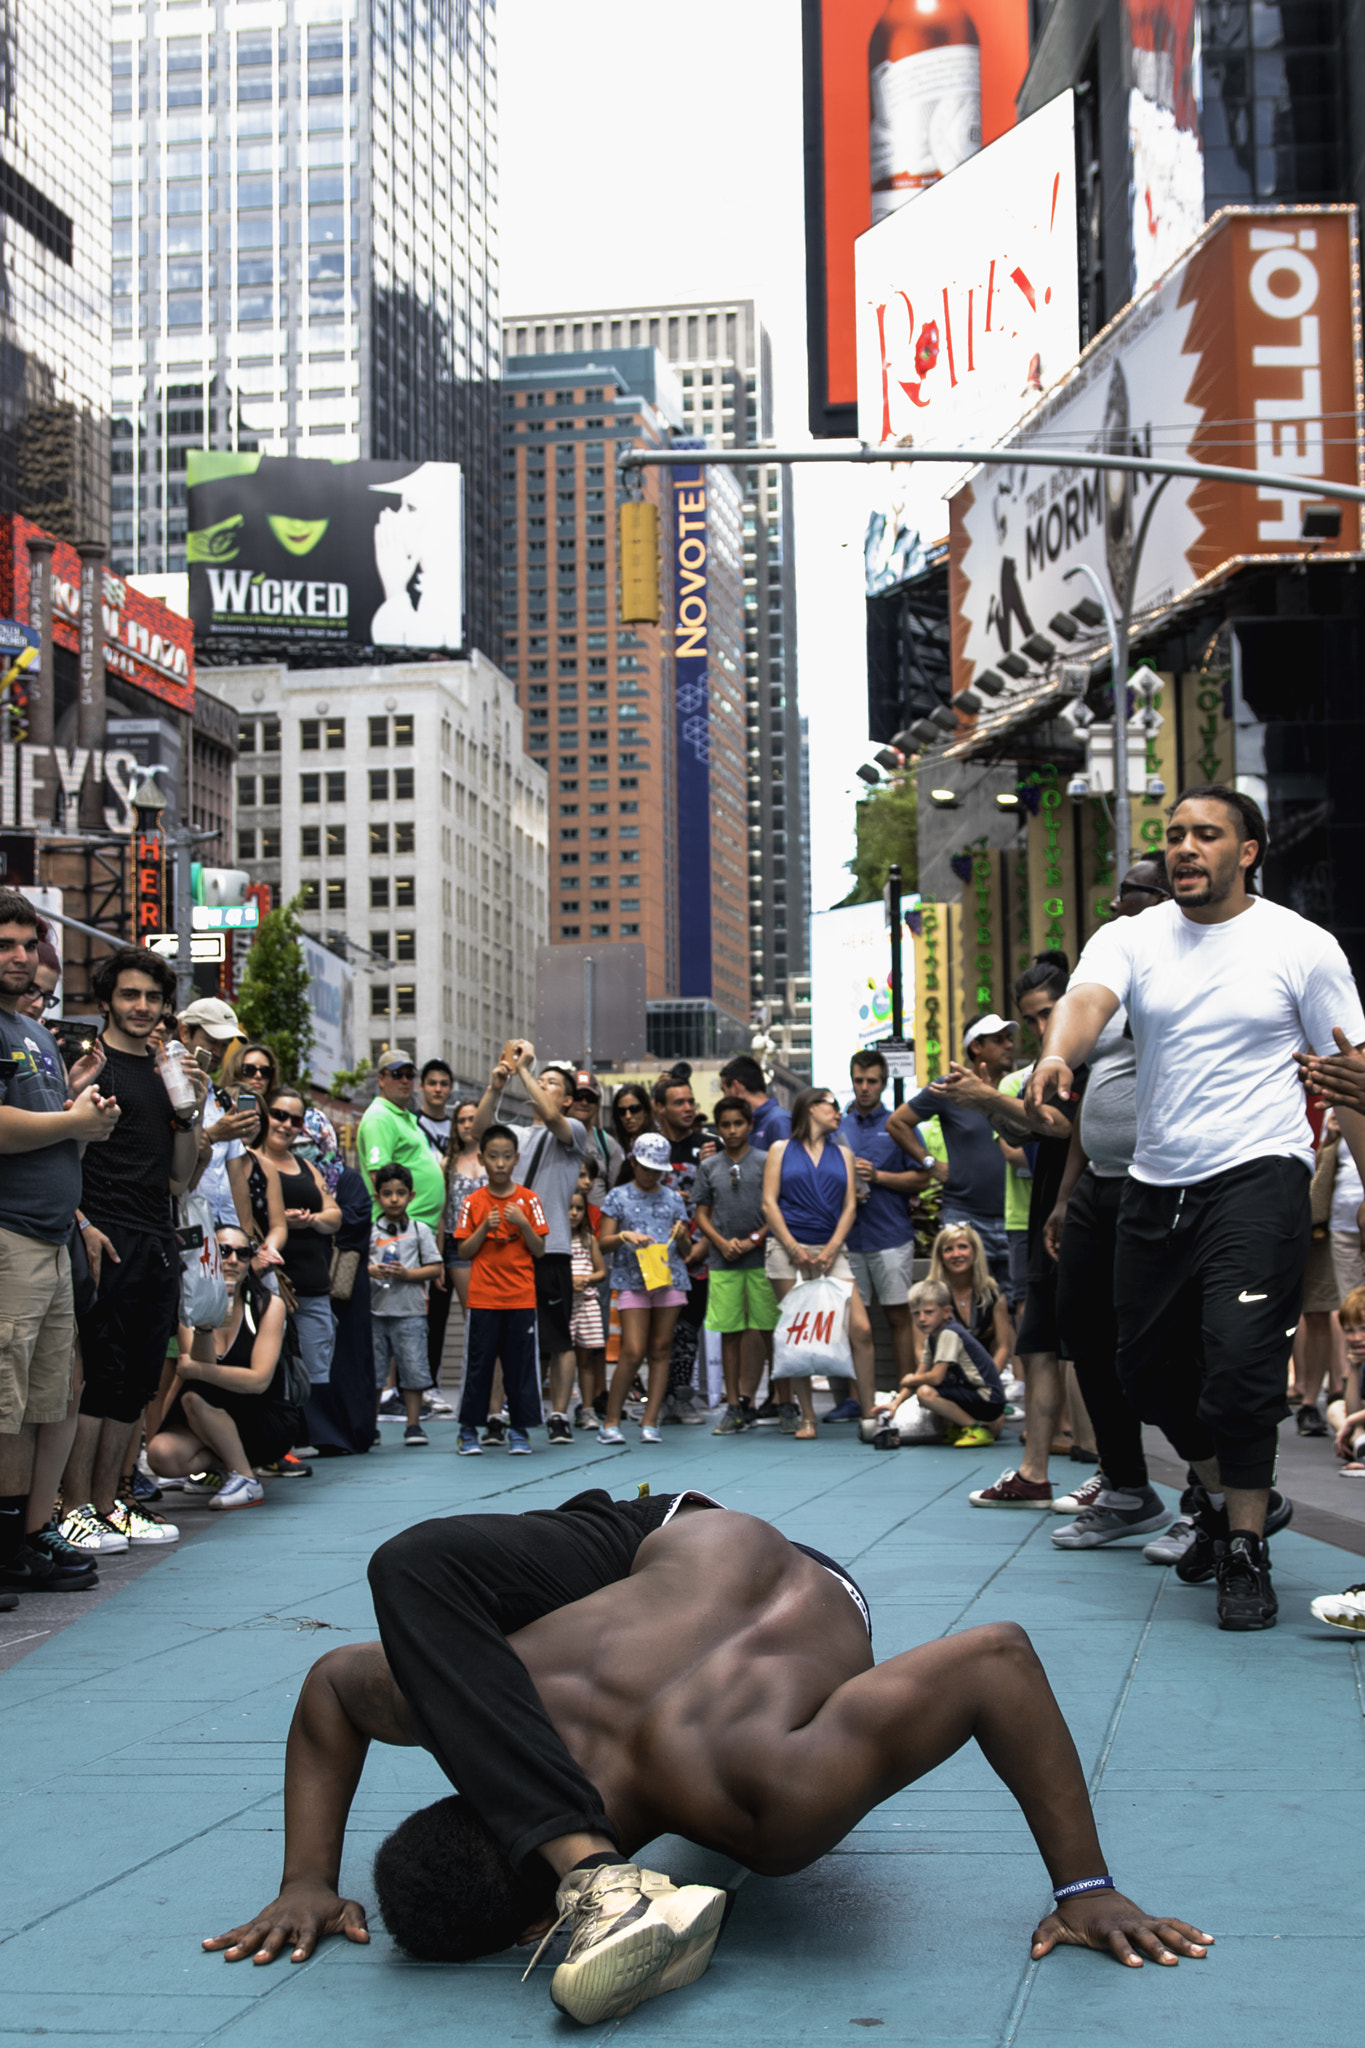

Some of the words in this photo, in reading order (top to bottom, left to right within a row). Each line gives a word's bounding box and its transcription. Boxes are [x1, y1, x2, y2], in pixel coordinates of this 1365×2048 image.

[1249, 228, 1326, 541] HELLO!
[674, 464, 708, 658] NOVOTEL
[1042, 789, 1063, 886] OLIVE
[973, 860, 993, 945] OLIVE
[786, 1310, 836, 1346] H&M
